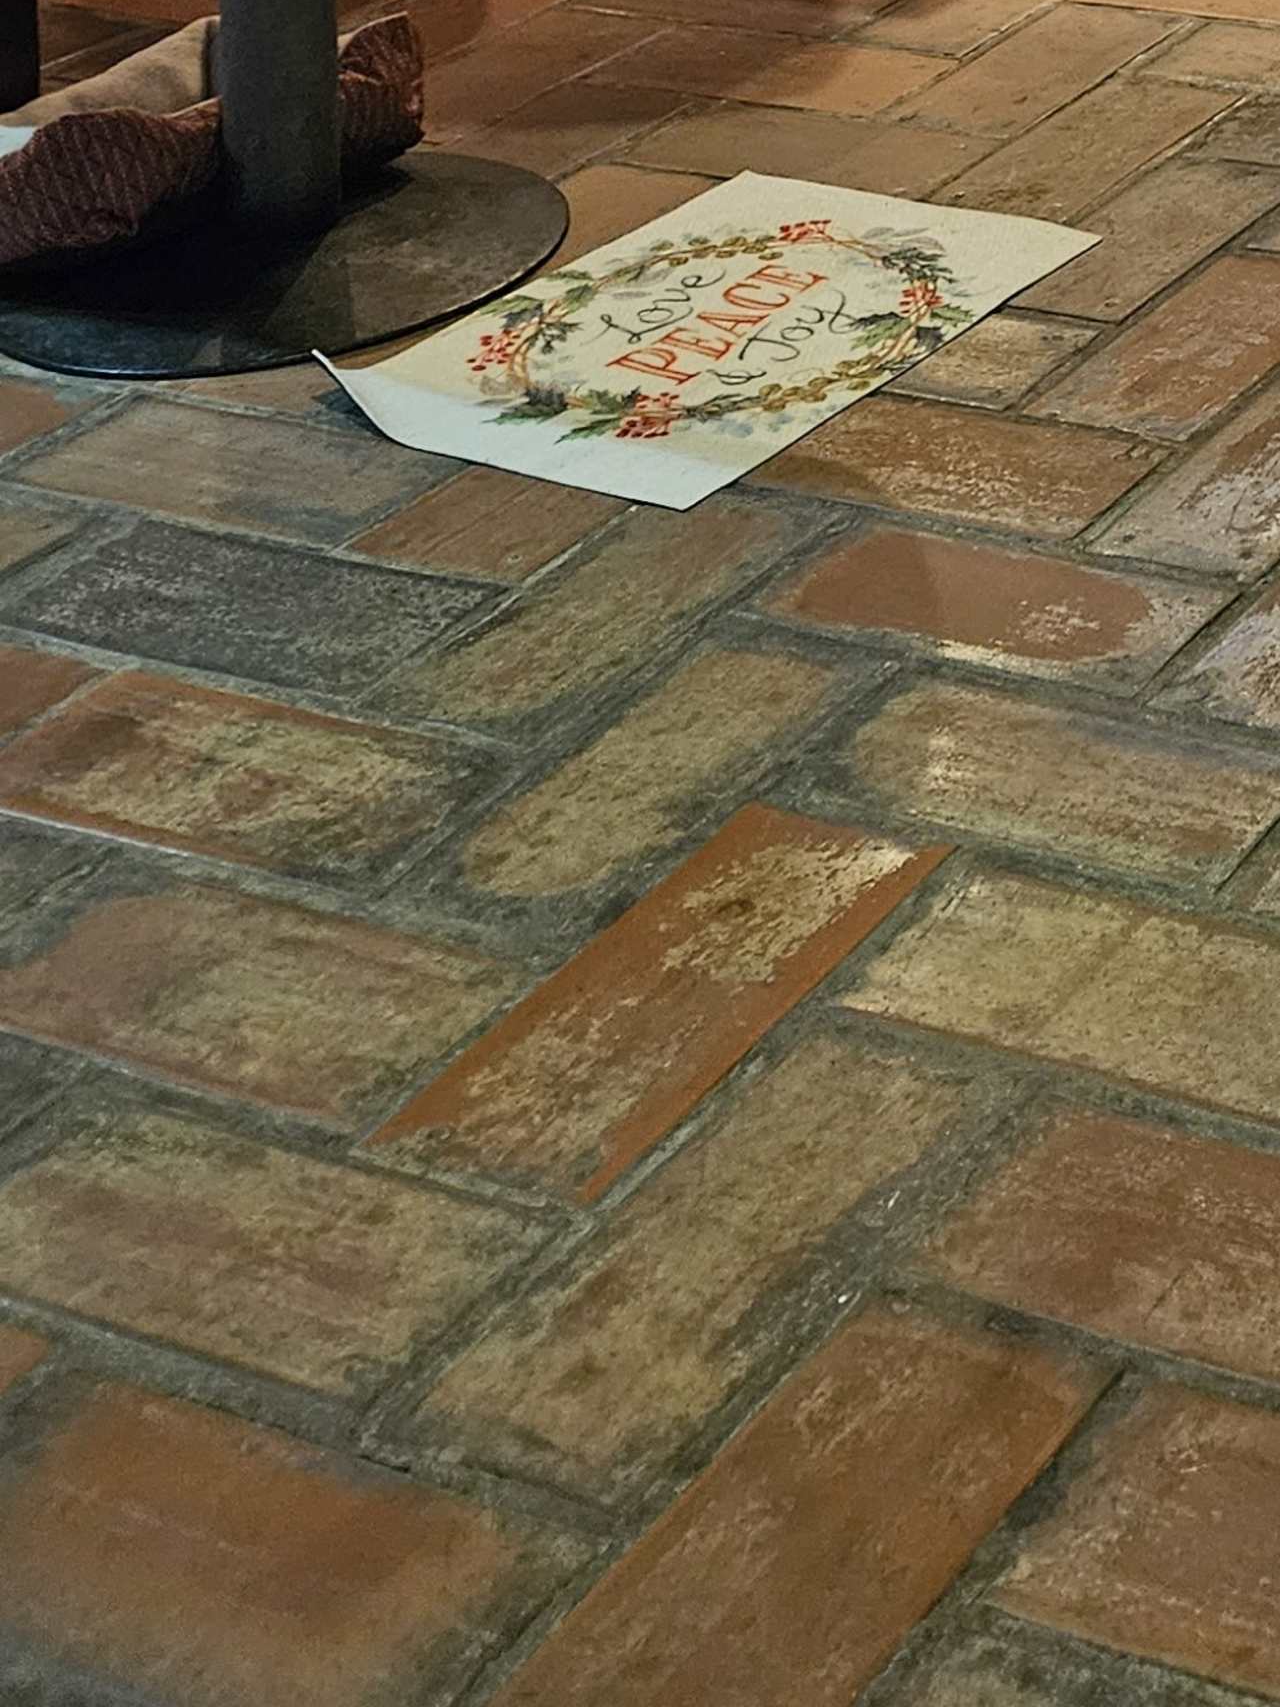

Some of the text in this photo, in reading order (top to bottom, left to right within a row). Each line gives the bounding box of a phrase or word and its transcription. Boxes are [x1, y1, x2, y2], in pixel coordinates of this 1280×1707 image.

[599, 267, 726, 344] Love
[606, 264, 829, 386] PEACE
[738, 289, 862, 363] Joy
